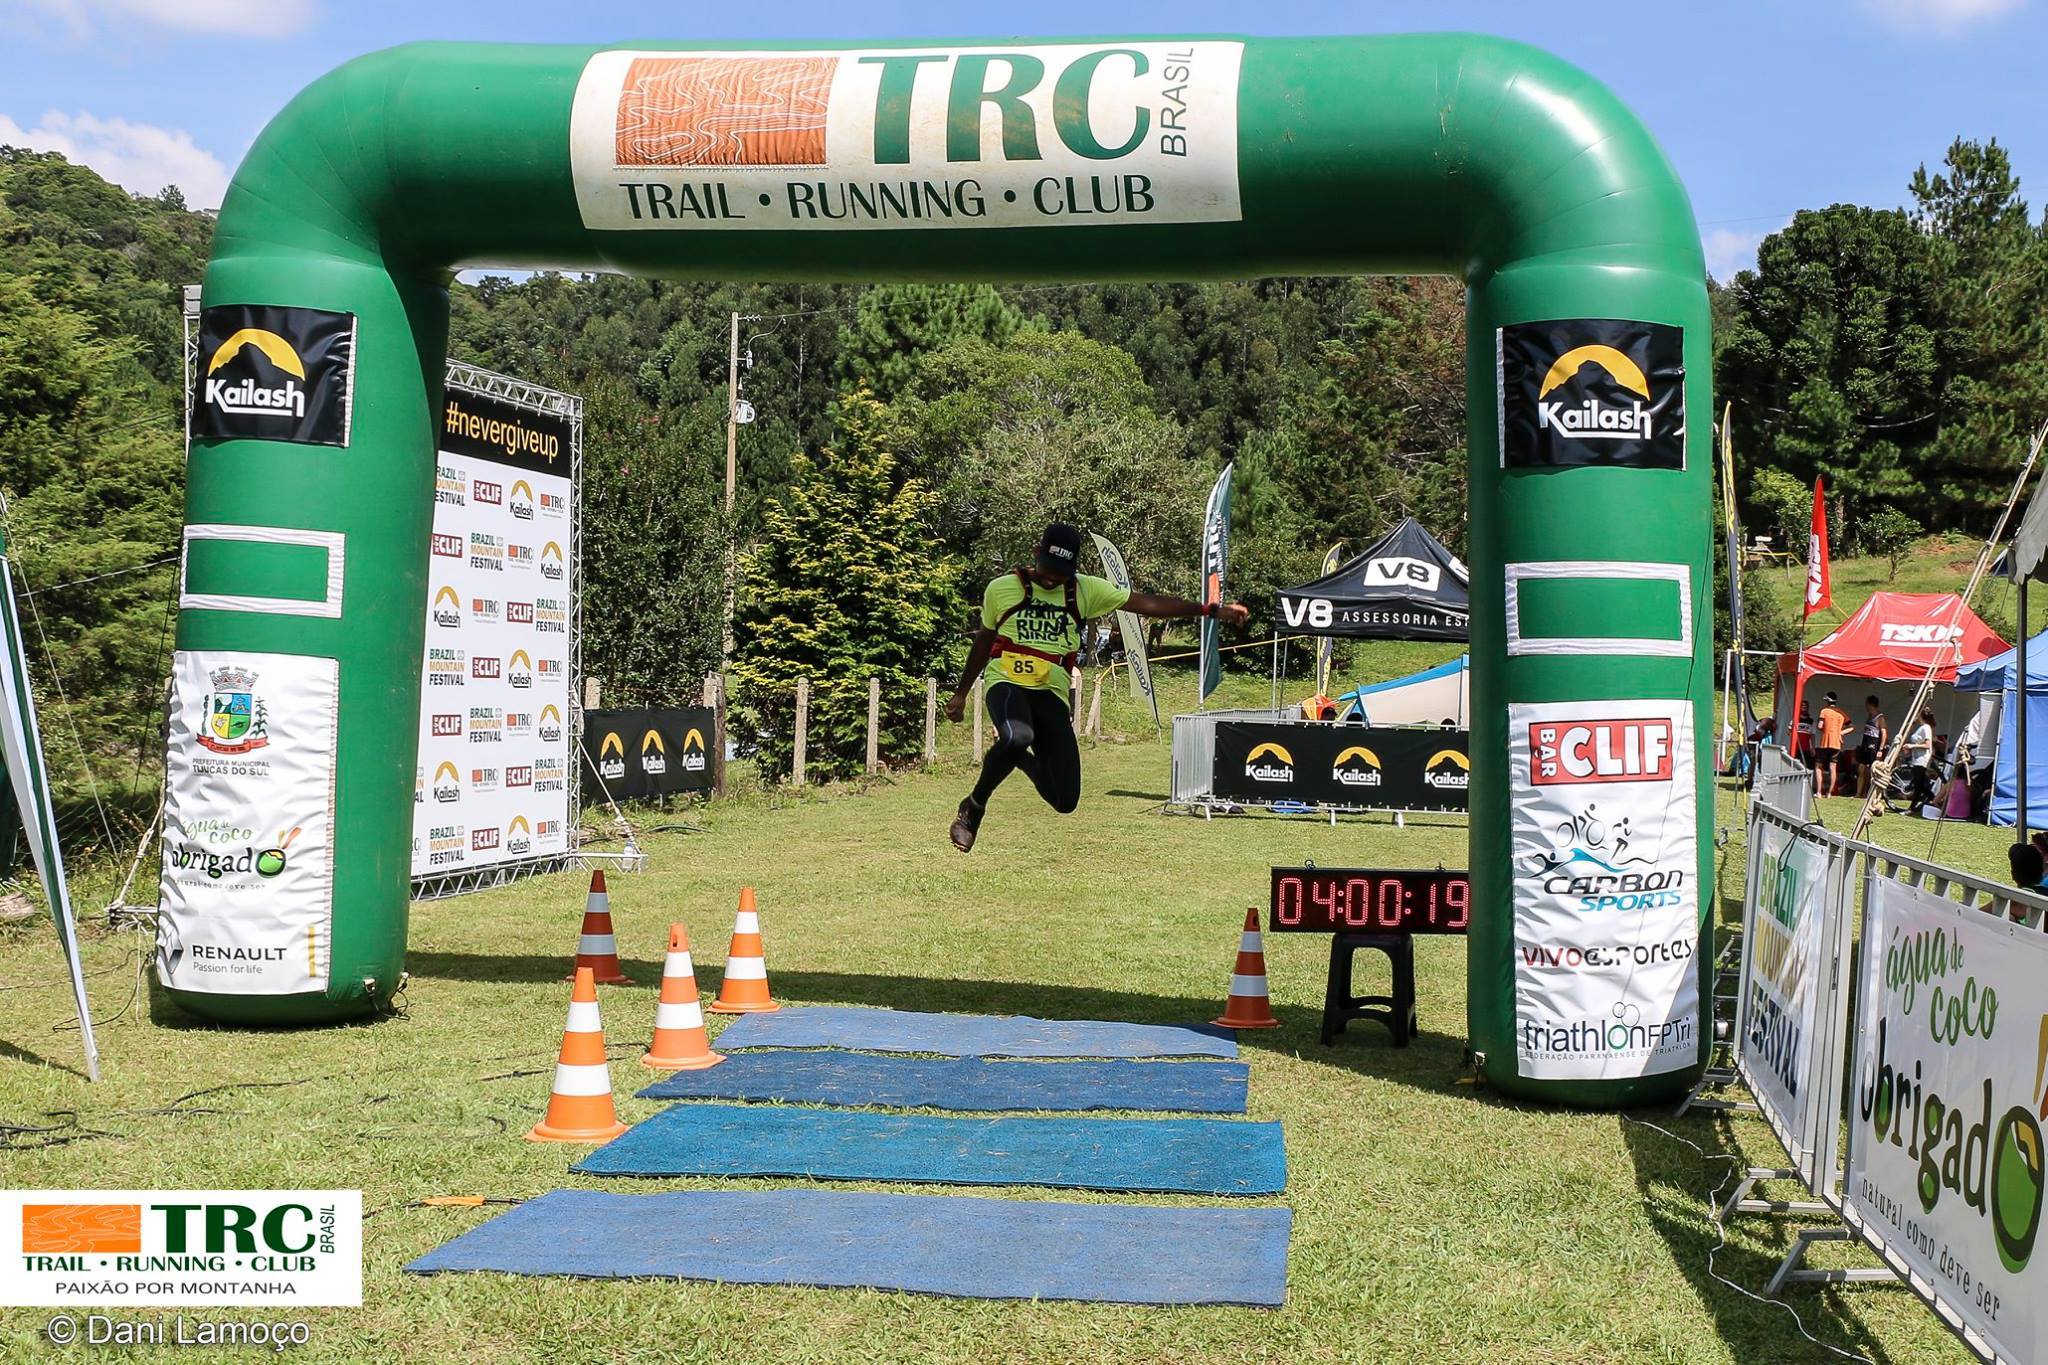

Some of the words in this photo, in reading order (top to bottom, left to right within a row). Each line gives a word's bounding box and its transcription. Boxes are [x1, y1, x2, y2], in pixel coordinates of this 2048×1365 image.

[857, 48, 1151, 165] TRC
[1160, 47, 1194, 157] BRASIL
[618, 183, 744, 219] TRAIL
[789, 177, 986, 219] RUNNING
[1034, 174, 1155, 216] CLUB
[205, 379, 305, 418] Kailash
[446, 401, 559, 463] #nevergiveup
[1538, 400, 1652, 440] Kailash
[437, 466, 456, 480] RAZIL
[435, 490, 465, 506] ESTIVAL
[1377, 562, 1430, 583] V8
[1281, 597, 1333, 628] V8
[1342, 610, 1437, 626] ASSESSORIA
[1013, 660, 1034, 674] 85
[1540, 728, 1557, 777] BAR
[1560, 725, 1668, 777] CLIF
[232, 767, 246, 775] DO
[249, 767, 269, 776] SUL
[1245, 764, 1293, 782] Kailash
[1332, 767, 1381, 786] Kailash
[209, 828, 253, 843] coco
[1278, 877, 1469, 927] 04:00:19
[1578, 890, 1681, 912] SPORTS
[192, 945, 287, 960] RENAULT
[193, 962, 227, 973] Passion
[230, 964, 244, 973] for
[246, 965, 263, 974] life
[1886, 926, 1948, 1015] água
[1951, 928, 1965, 973] de
[1930, 977, 1999, 1046] coco
[1655, 1042, 1691, 1056] TRIATHLON
[1862, 1178, 1902, 1231] natural
[1906, 1219, 1935, 1260] como
[1939, 1244, 1970, 1294] deve
[1976, 1281, 2000, 1321] ser
